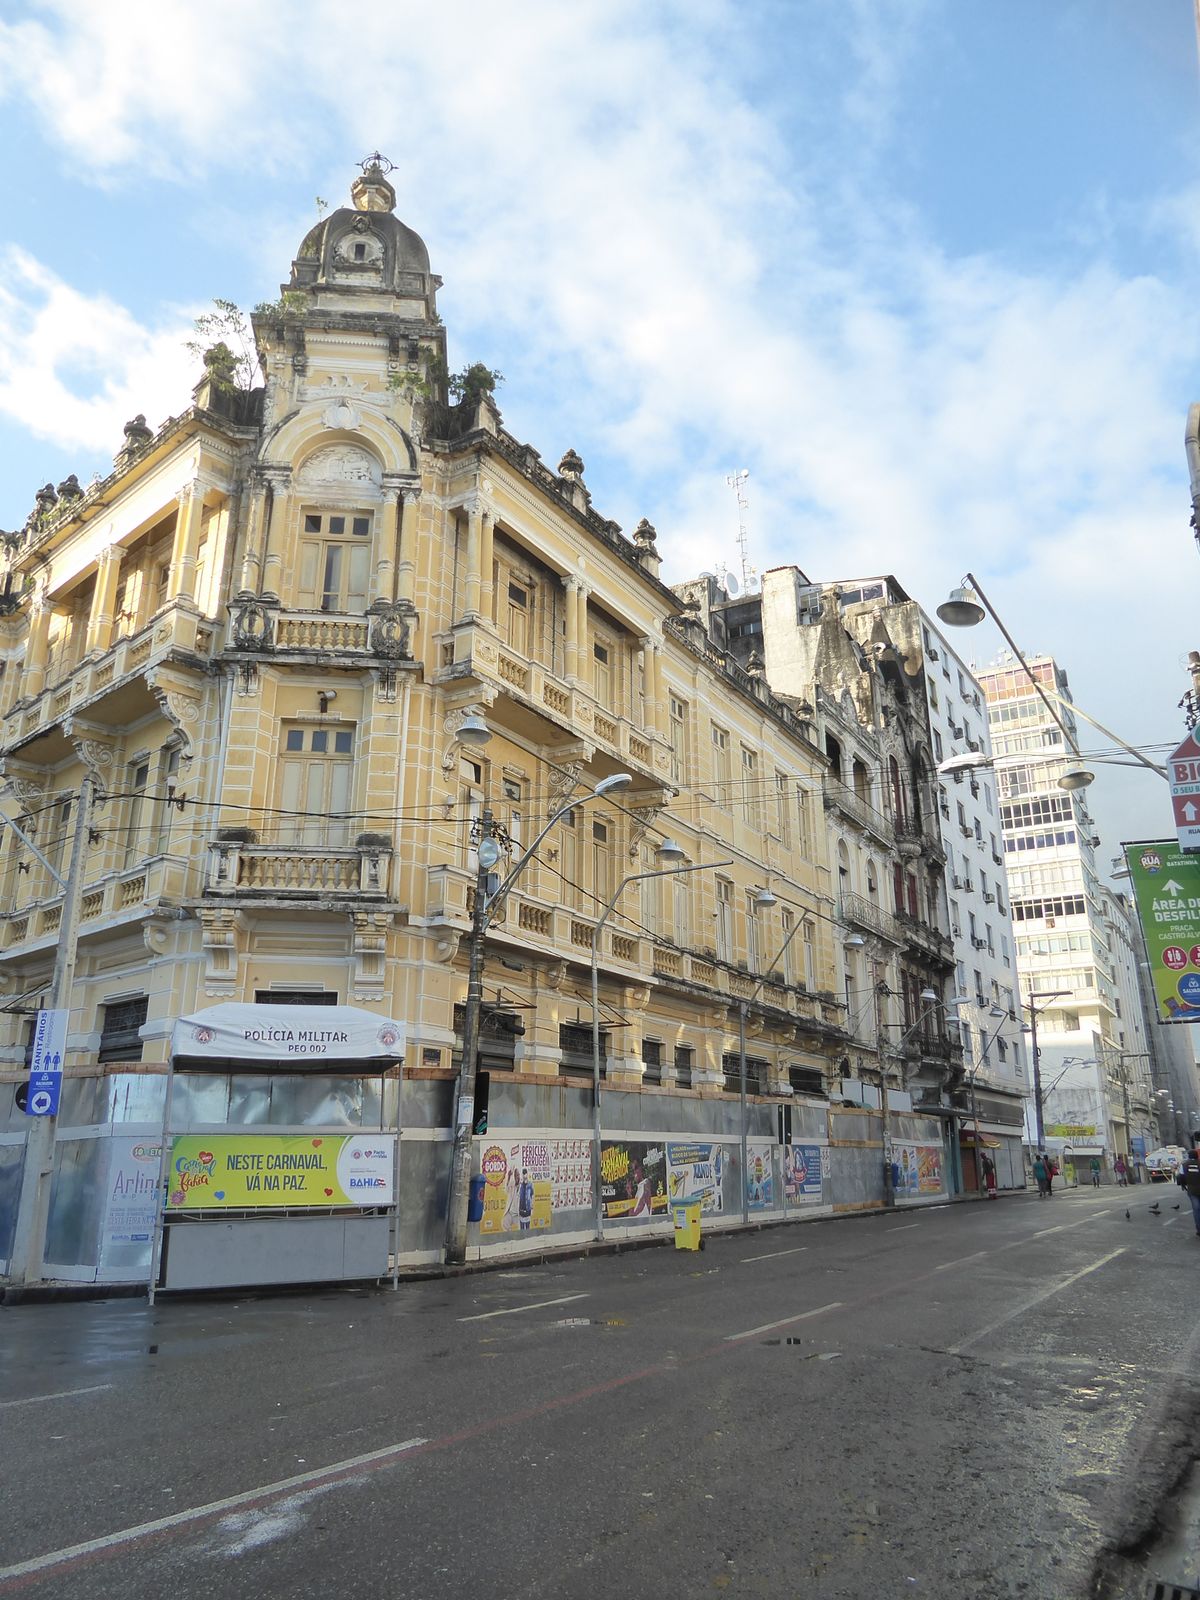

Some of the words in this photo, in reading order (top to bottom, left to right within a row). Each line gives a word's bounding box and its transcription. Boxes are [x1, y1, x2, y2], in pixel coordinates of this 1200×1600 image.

[1141, 855, 1160, 867] RUA
[1152, 897, 1186, 911] ÁREA
[1154, 910, 1200, 922] DESFIL
[1158, 932, 1186, 940] CASTRO
[244, 1027, 294, 1041] POLÍCIA
[298, 1031, 348, 1042] MILITAR
[33, 1012, 48, 1071] SANITÁRIOS
[288, 1045, 307, 1053] PEO
[309, 1044, 327, 1053] 002
[227, 1154, 264, 1171] NESTE
[266, 1153, 328, 1171] CARNAVAL,
[485, 1160, 505, 1172] GORDO
[246, 1172, 261, 1191] VÁ
[263, 1175, 280, 1191] NA
[282, 1174, 308, 1191] PAZ.
[350, 1178, 379, 1187] BAHIA
